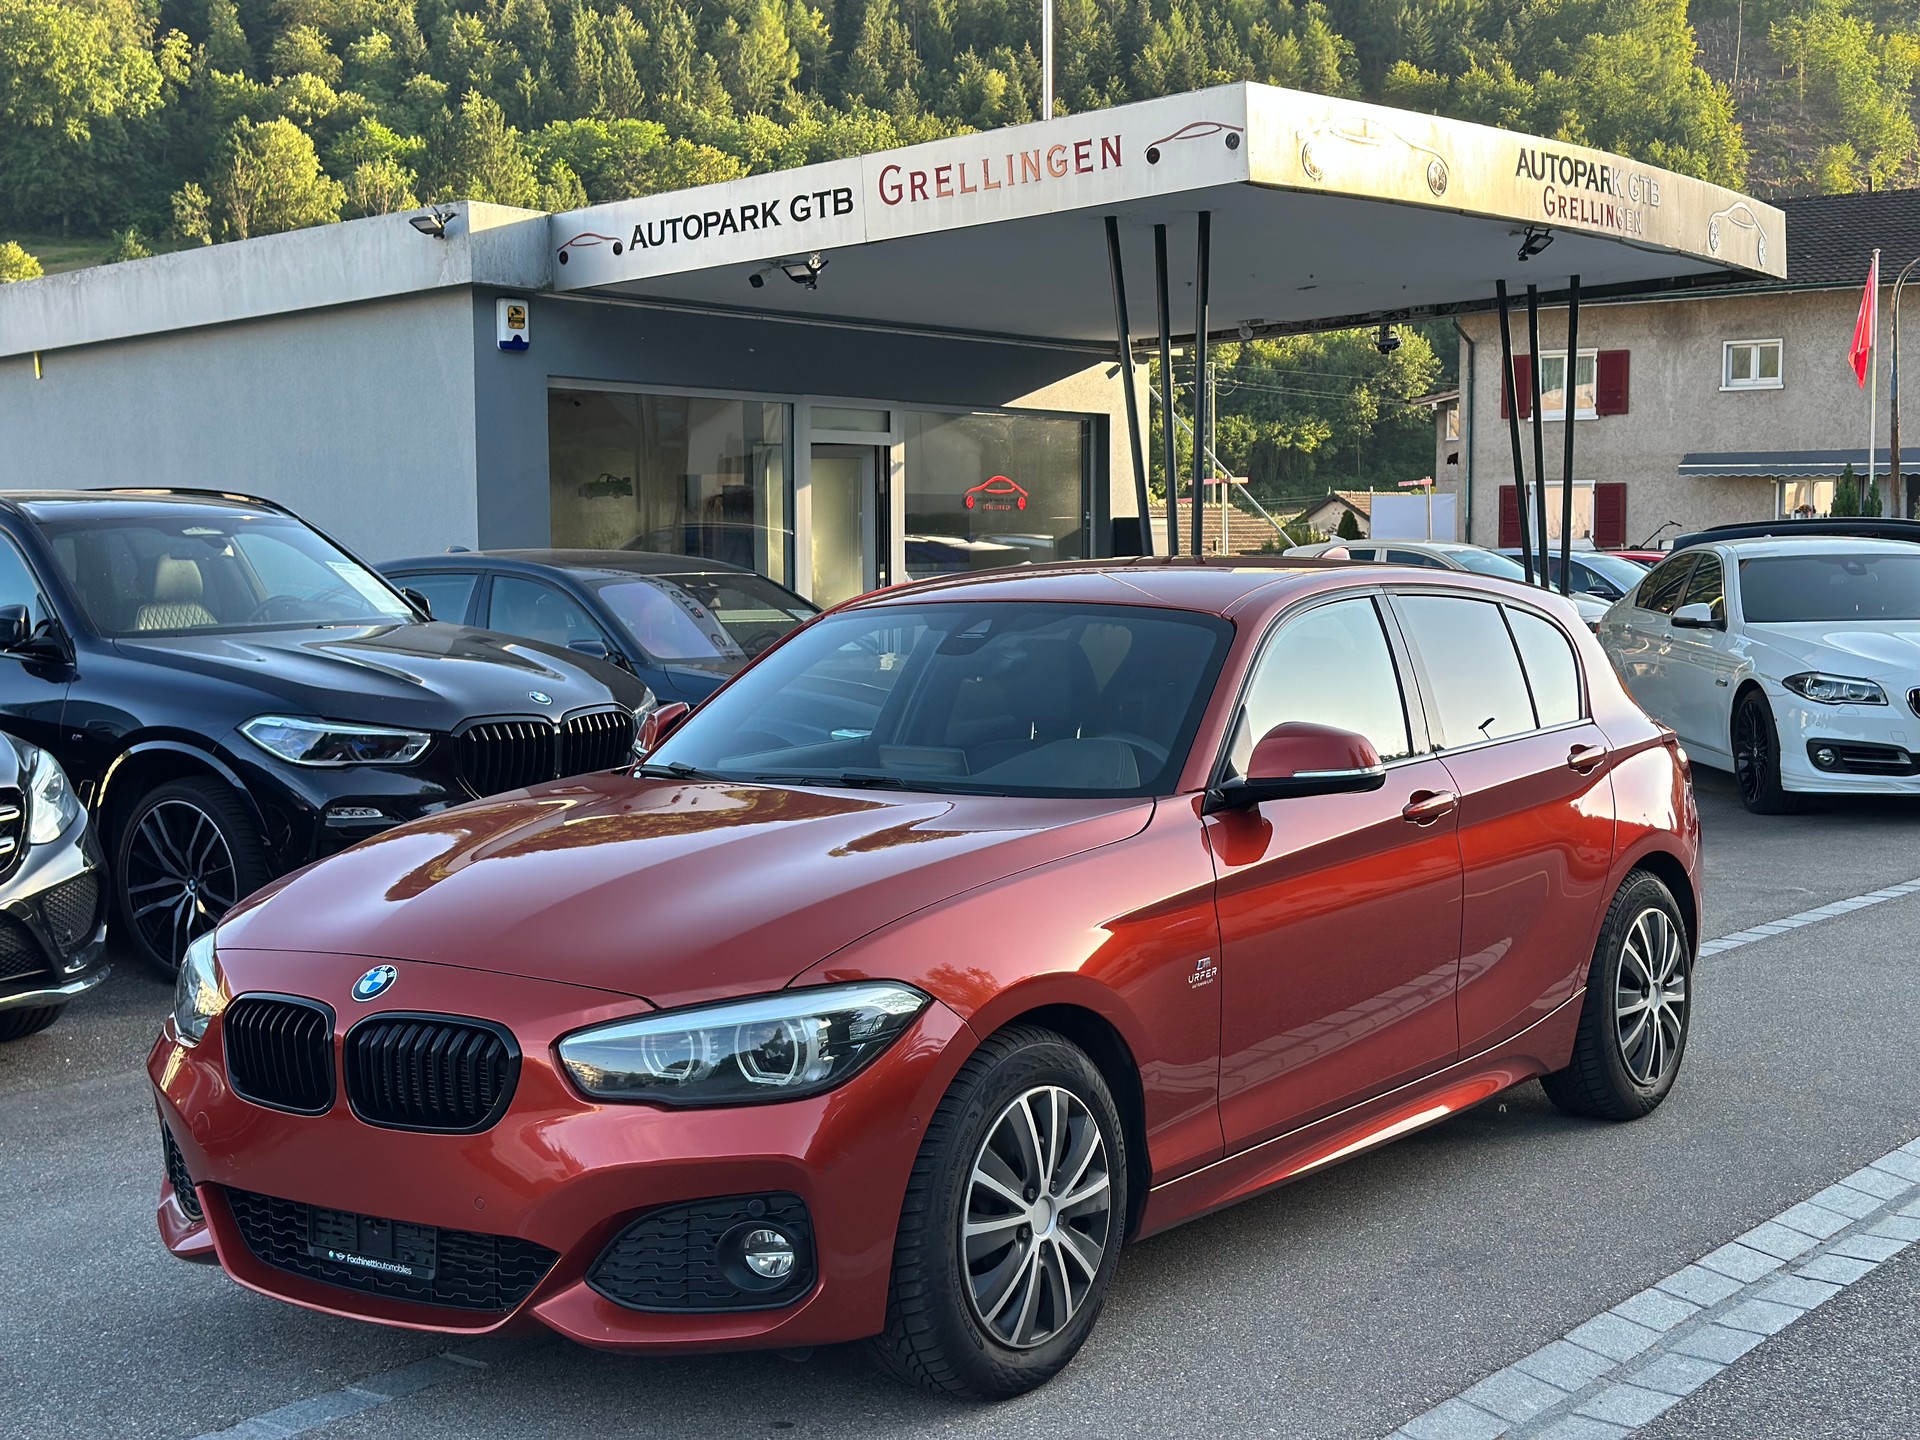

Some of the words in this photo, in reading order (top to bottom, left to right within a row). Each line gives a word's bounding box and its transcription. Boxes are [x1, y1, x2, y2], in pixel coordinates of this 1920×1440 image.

[878, 134, 1123, 206] GRELLINGEN
[1515, 147, 1624, 199] AUTOPARK
[1628, 172, 1661, 208] GTB
[629, 199, 781, 251] AUTOPARK
[789, 186, 854, 222] GTB
[1543, 185, 1643, 235] GRELLINGEN
[1188, 966, 1218, 984] URFER
